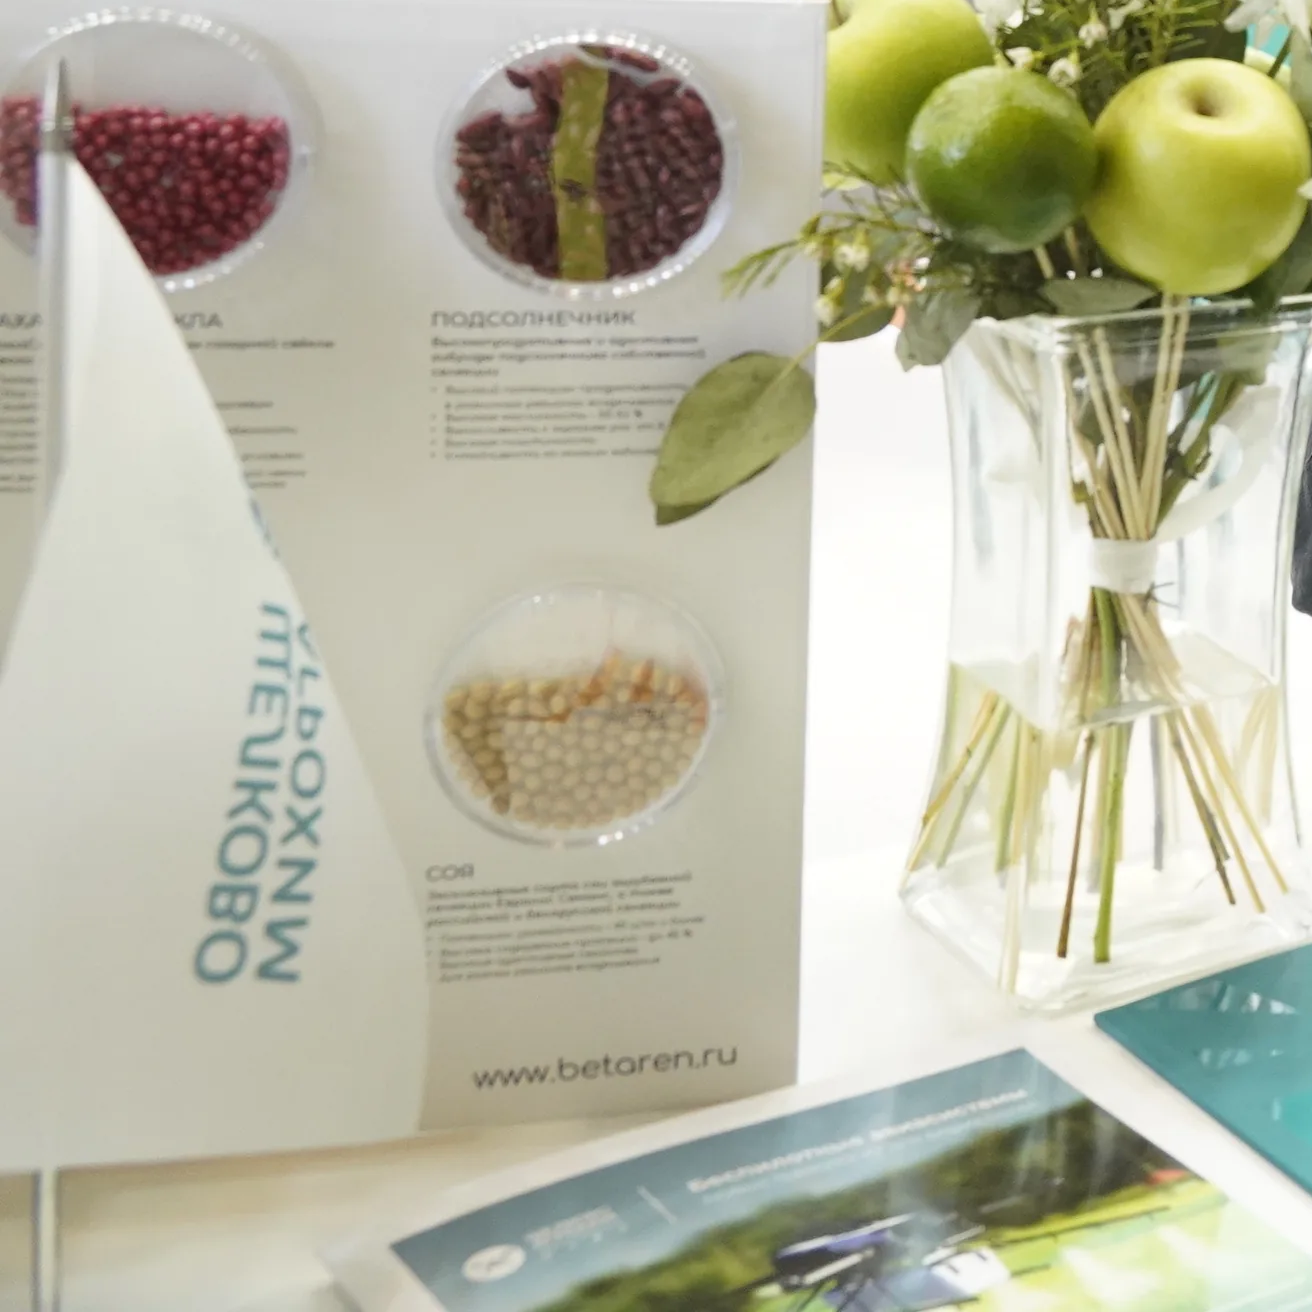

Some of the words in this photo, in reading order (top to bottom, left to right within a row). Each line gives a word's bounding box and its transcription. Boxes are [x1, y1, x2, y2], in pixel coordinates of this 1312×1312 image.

[430, 309, 636, 330] ПОДСОЛНЕЧНИК
[425, 863, 475, 883] СОЯ
[473, 1045, 739, 1090] www.betaren.ru
